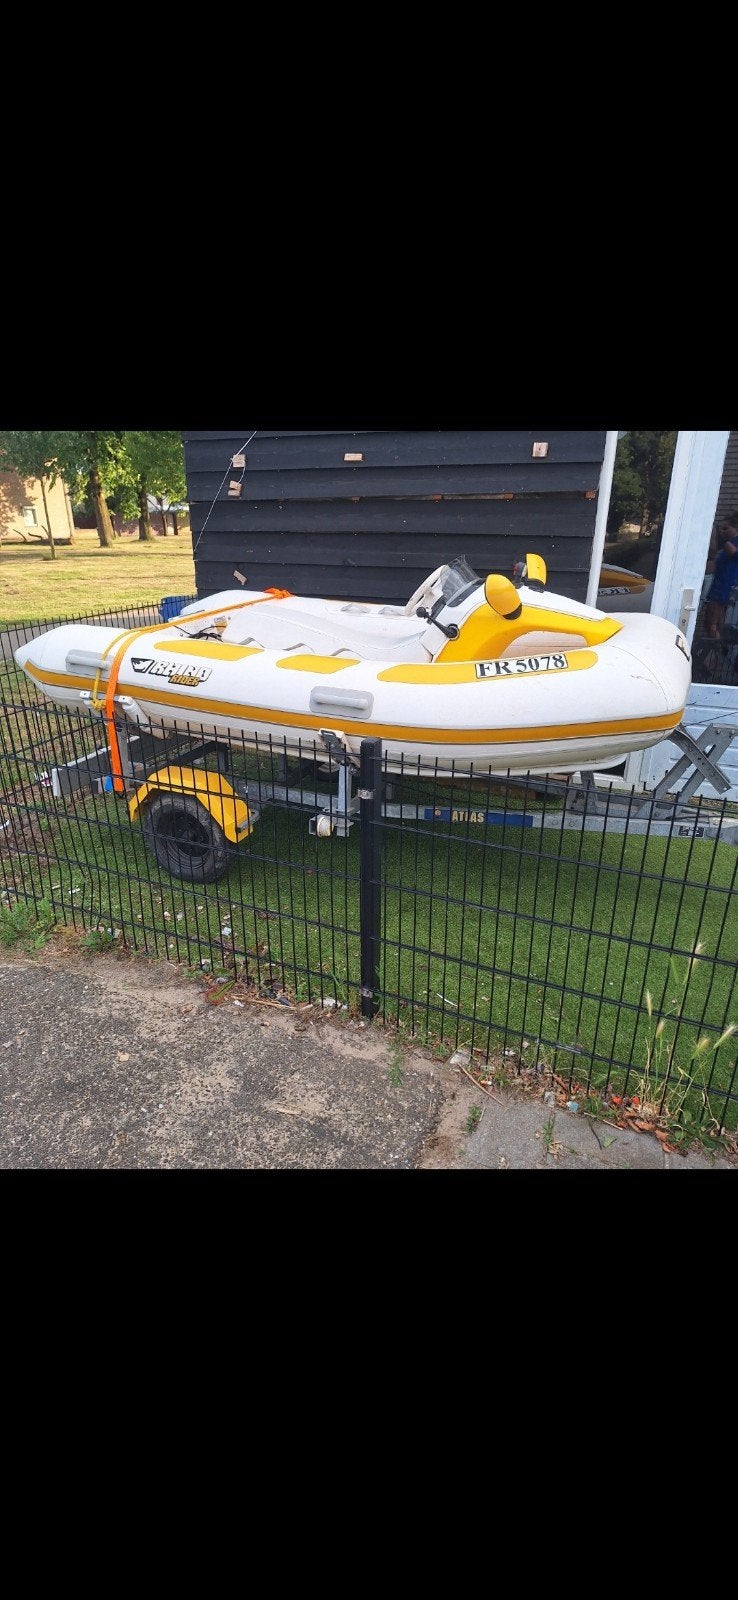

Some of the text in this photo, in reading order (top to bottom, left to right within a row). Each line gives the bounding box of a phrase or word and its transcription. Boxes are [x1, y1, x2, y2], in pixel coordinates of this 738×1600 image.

[148, 660, 213, 682] RHINO
[479, 655, 566, 676] FR 5078
[169, 674, 200, 686] RIDER
